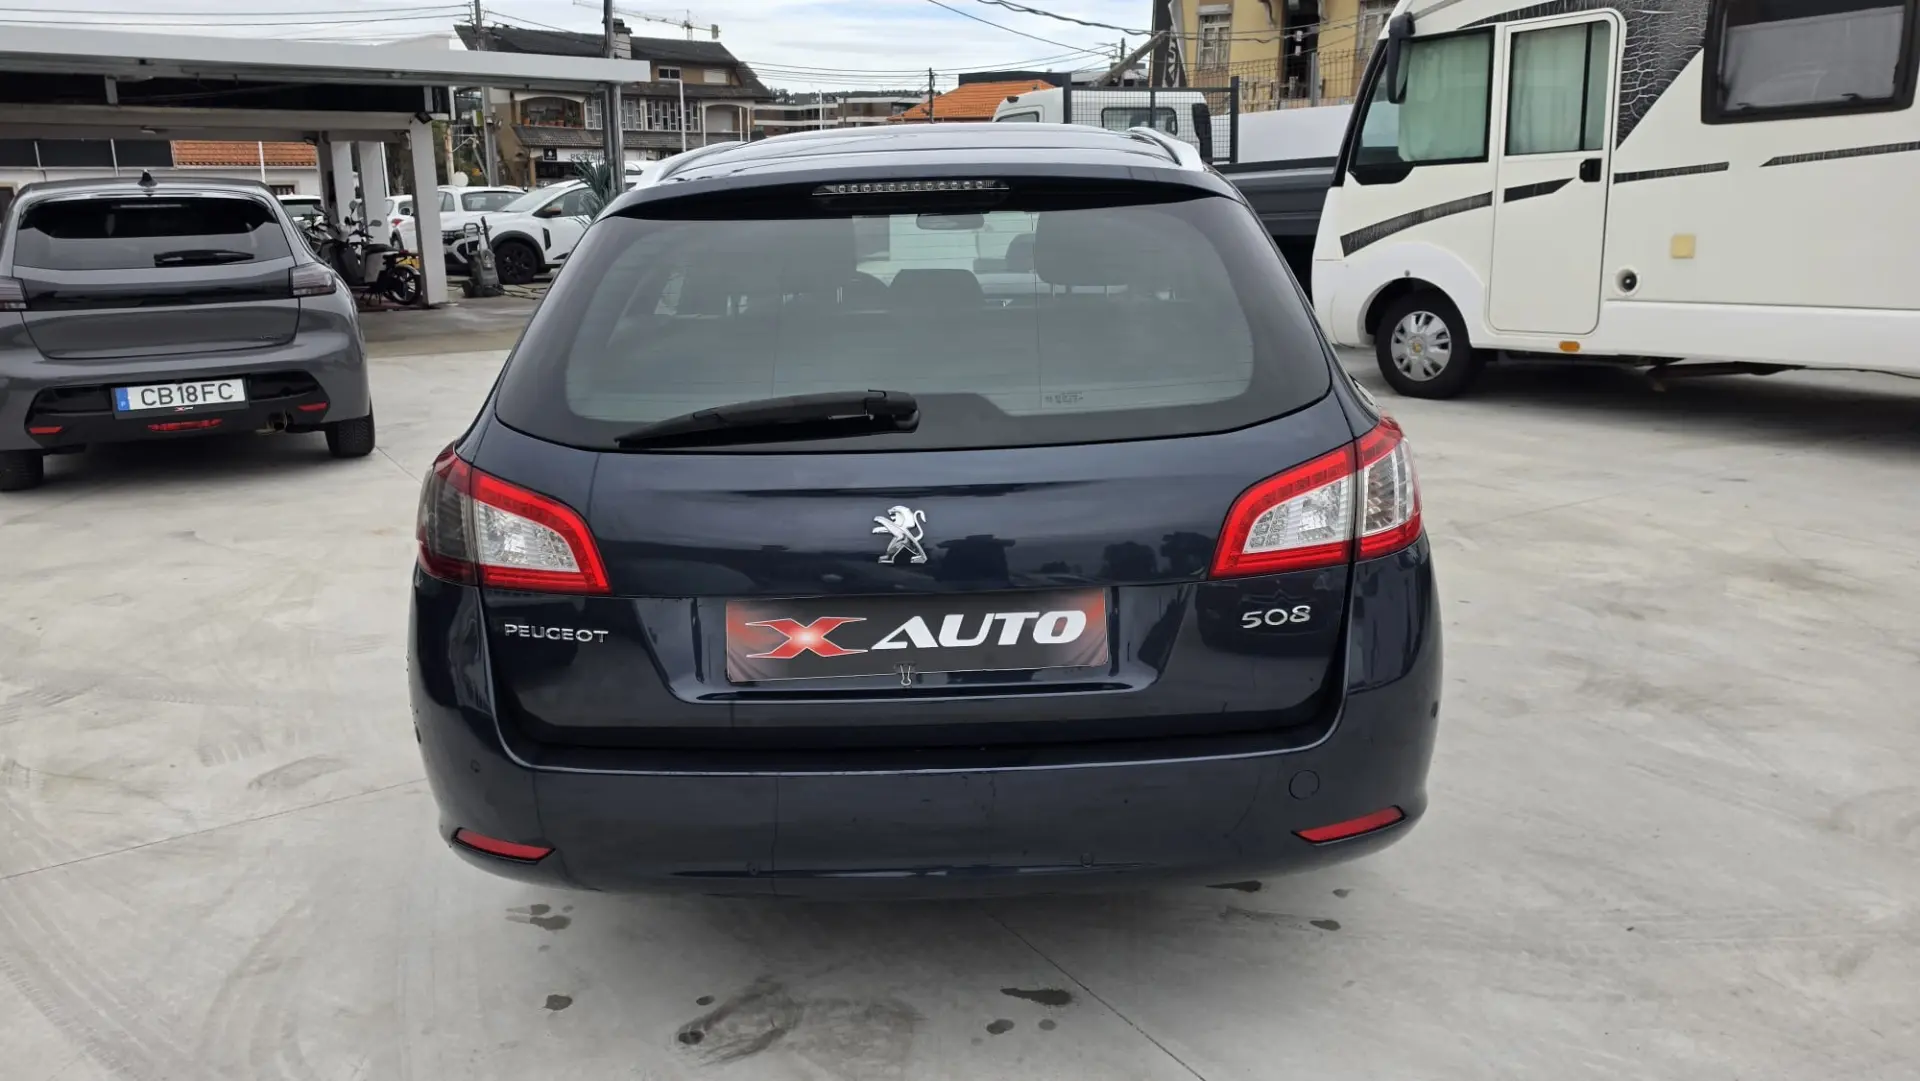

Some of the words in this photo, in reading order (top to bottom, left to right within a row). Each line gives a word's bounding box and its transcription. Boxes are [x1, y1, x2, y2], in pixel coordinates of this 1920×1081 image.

[141, 382, 233, 406] CB18FC
[1241, 605, 1311, 629] 508
[504, 623, 609, 643] PEUGEOT
[745, 616, 869, 659] X
[871, 610, 1087, 650] AUTO
